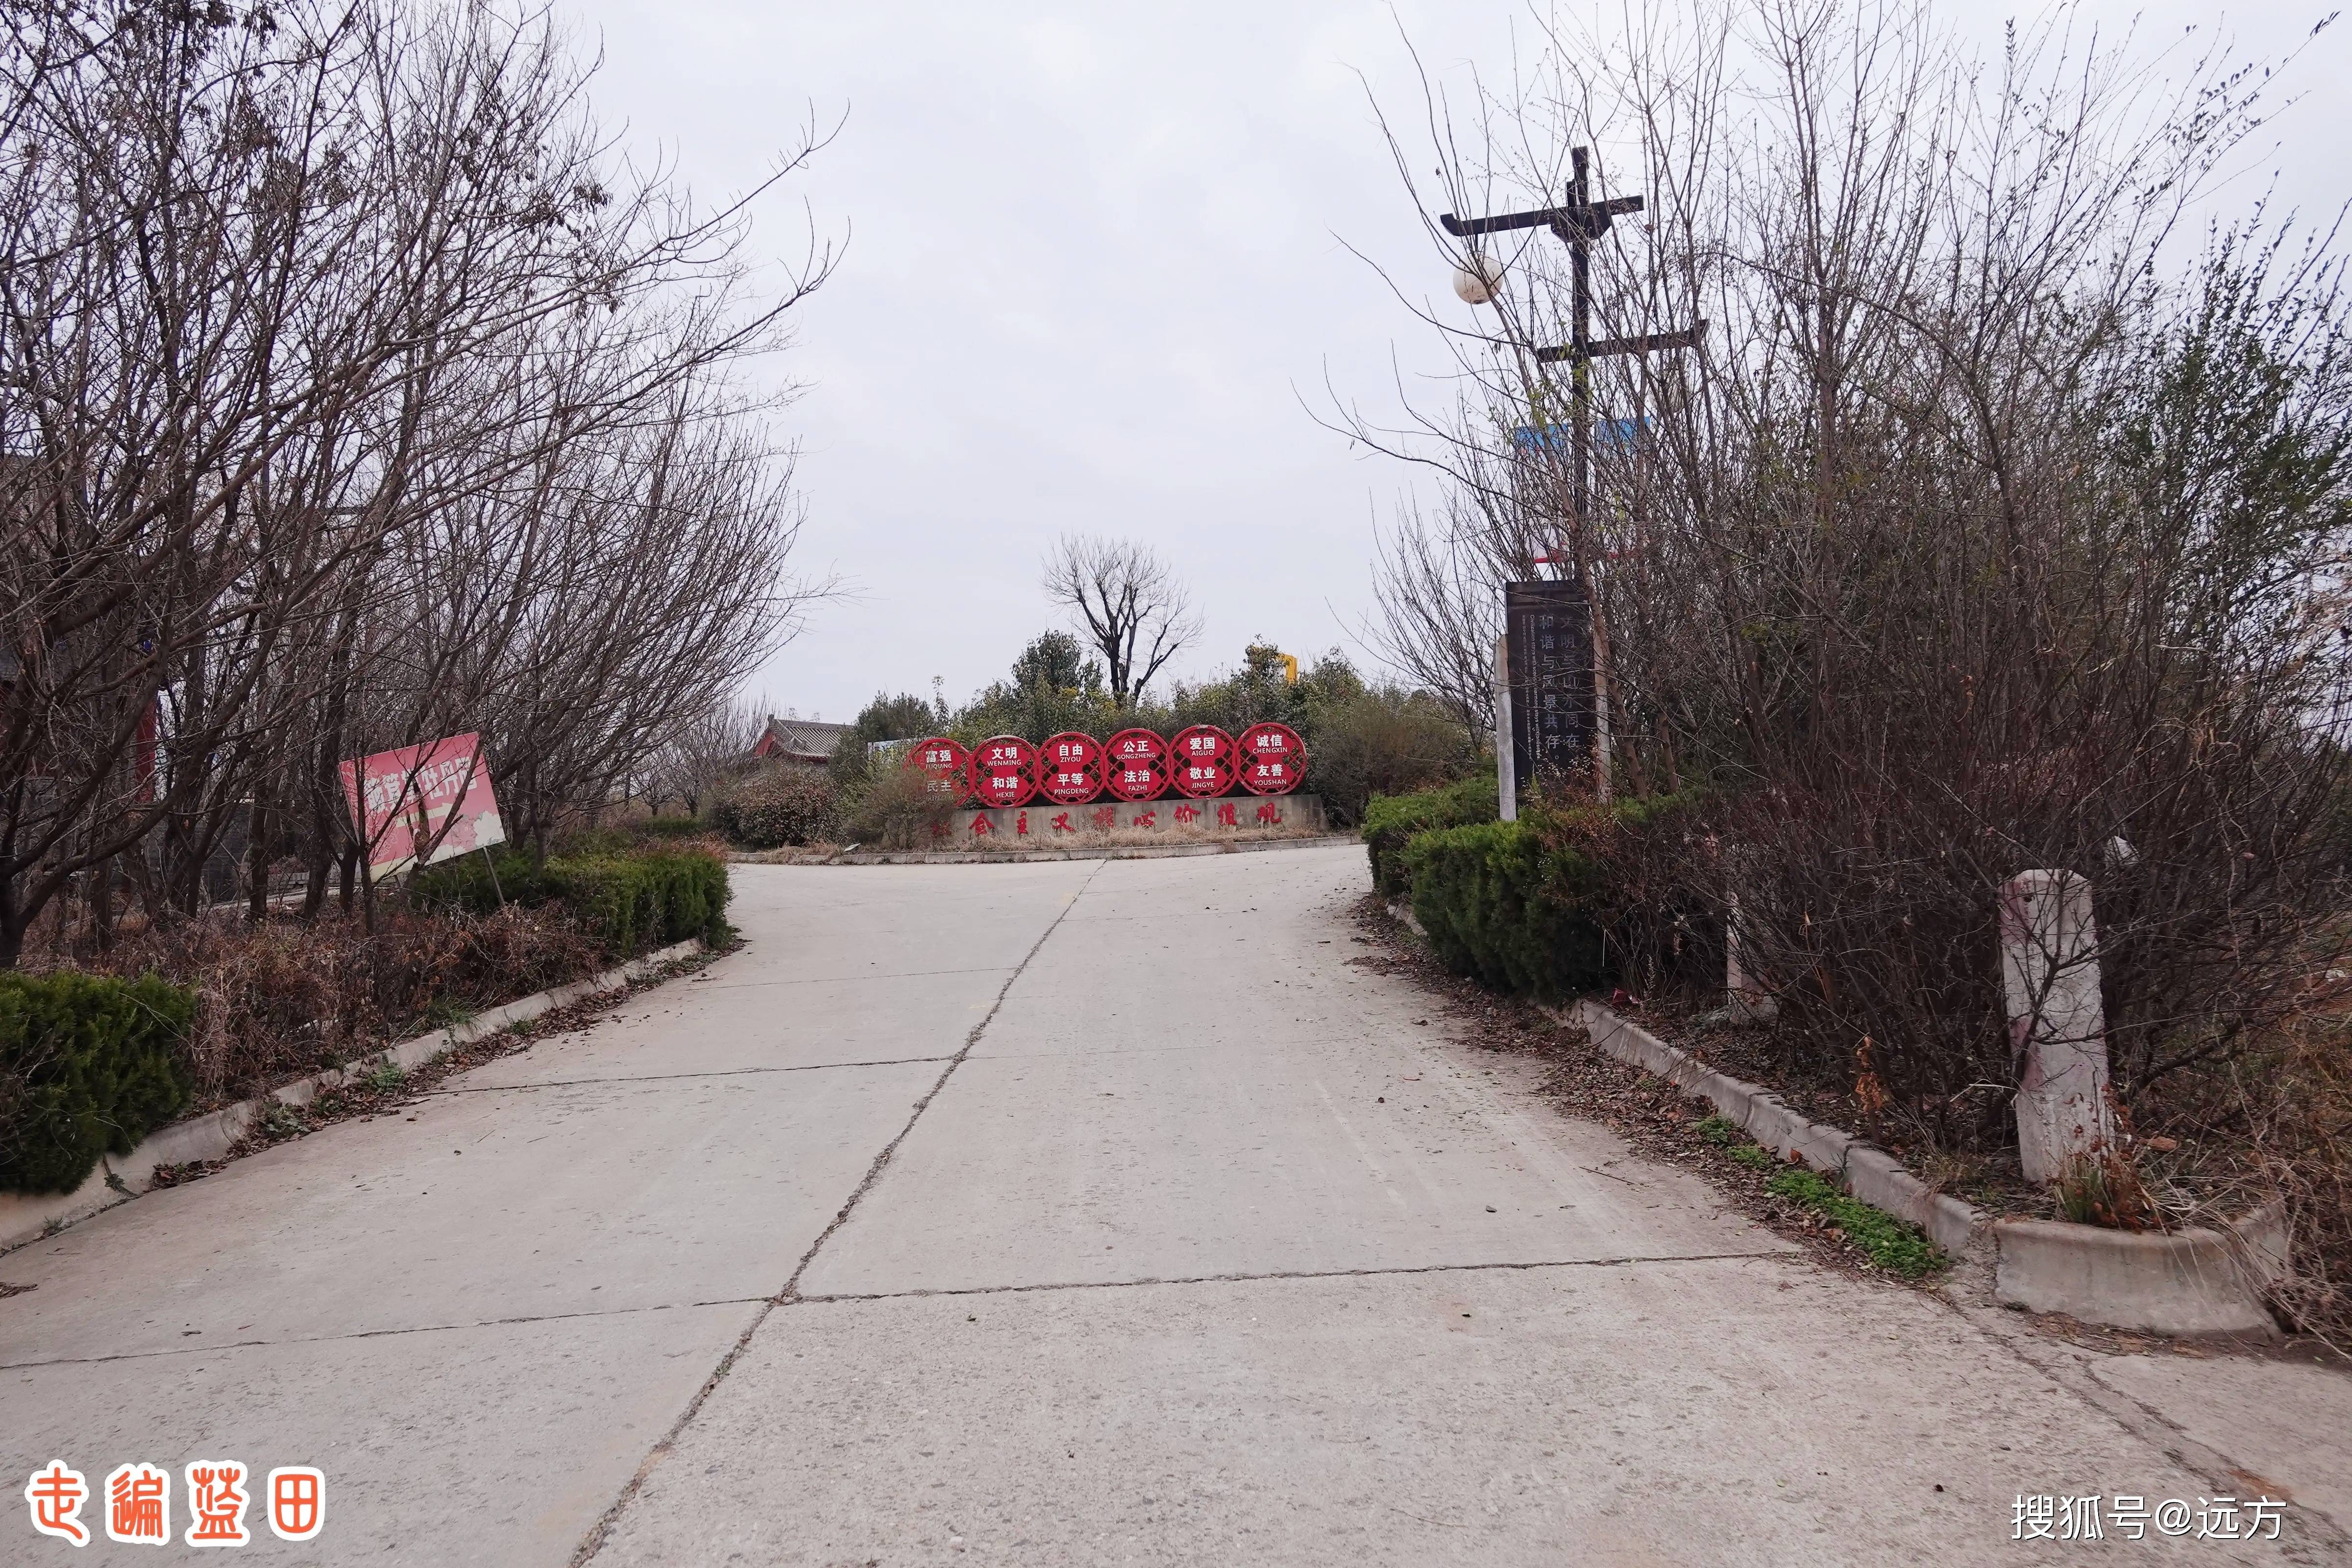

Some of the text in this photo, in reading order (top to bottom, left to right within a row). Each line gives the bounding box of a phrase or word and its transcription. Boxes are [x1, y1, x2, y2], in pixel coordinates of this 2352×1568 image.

[1123, 740, 1149, 753] 公正
[1190, 737, 1215, 750] 爱国
[1256, 735, 1283, 747] 诚信
[926, 750, 952, 763] 富强
[991, 747, 1017, 760] 文明
[1059, 744, 1083, 757] 自由
[1124, 770, 1151, 783] 法治
[1189, 767, 1216, 780] 敬业
[1257, 764, 1283, 777] 友善
[927, 780, 952, 792] 民主
[992, 776, 1019, 789] 和谐
[1057, 773, 1084, 786] 平等
